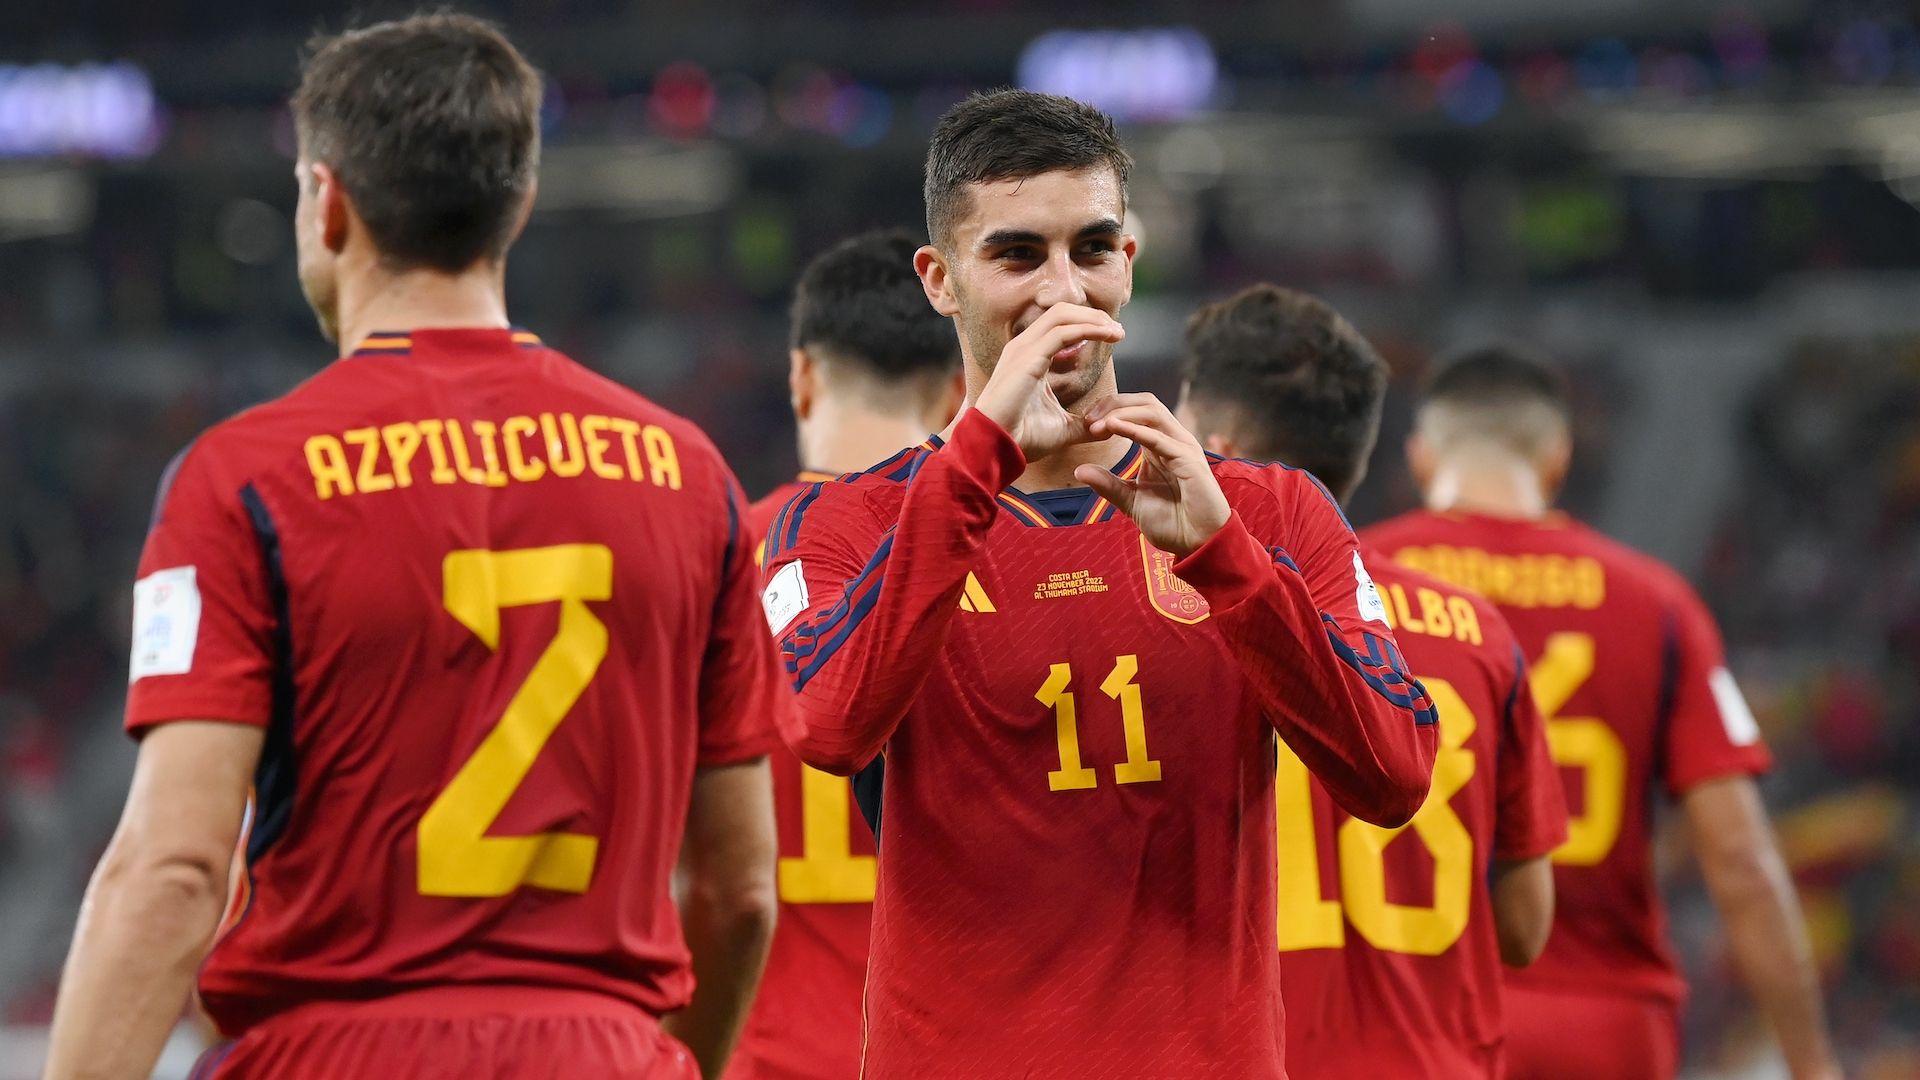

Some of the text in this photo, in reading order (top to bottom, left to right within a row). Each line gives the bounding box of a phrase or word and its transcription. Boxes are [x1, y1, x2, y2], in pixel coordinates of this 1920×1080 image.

[303, 412, 683, 500] AZPILICUETA
[1034, 584, 1109, 600] AL THUMAMA STADIUM
[1036, 576, 1104, 591] 23 NOVEMBER 2022
[1048, 569, 1089, 582] COSTA RICA
[417, 543, 614, 897] 2
[1034, 653, 1162, 792] 11
